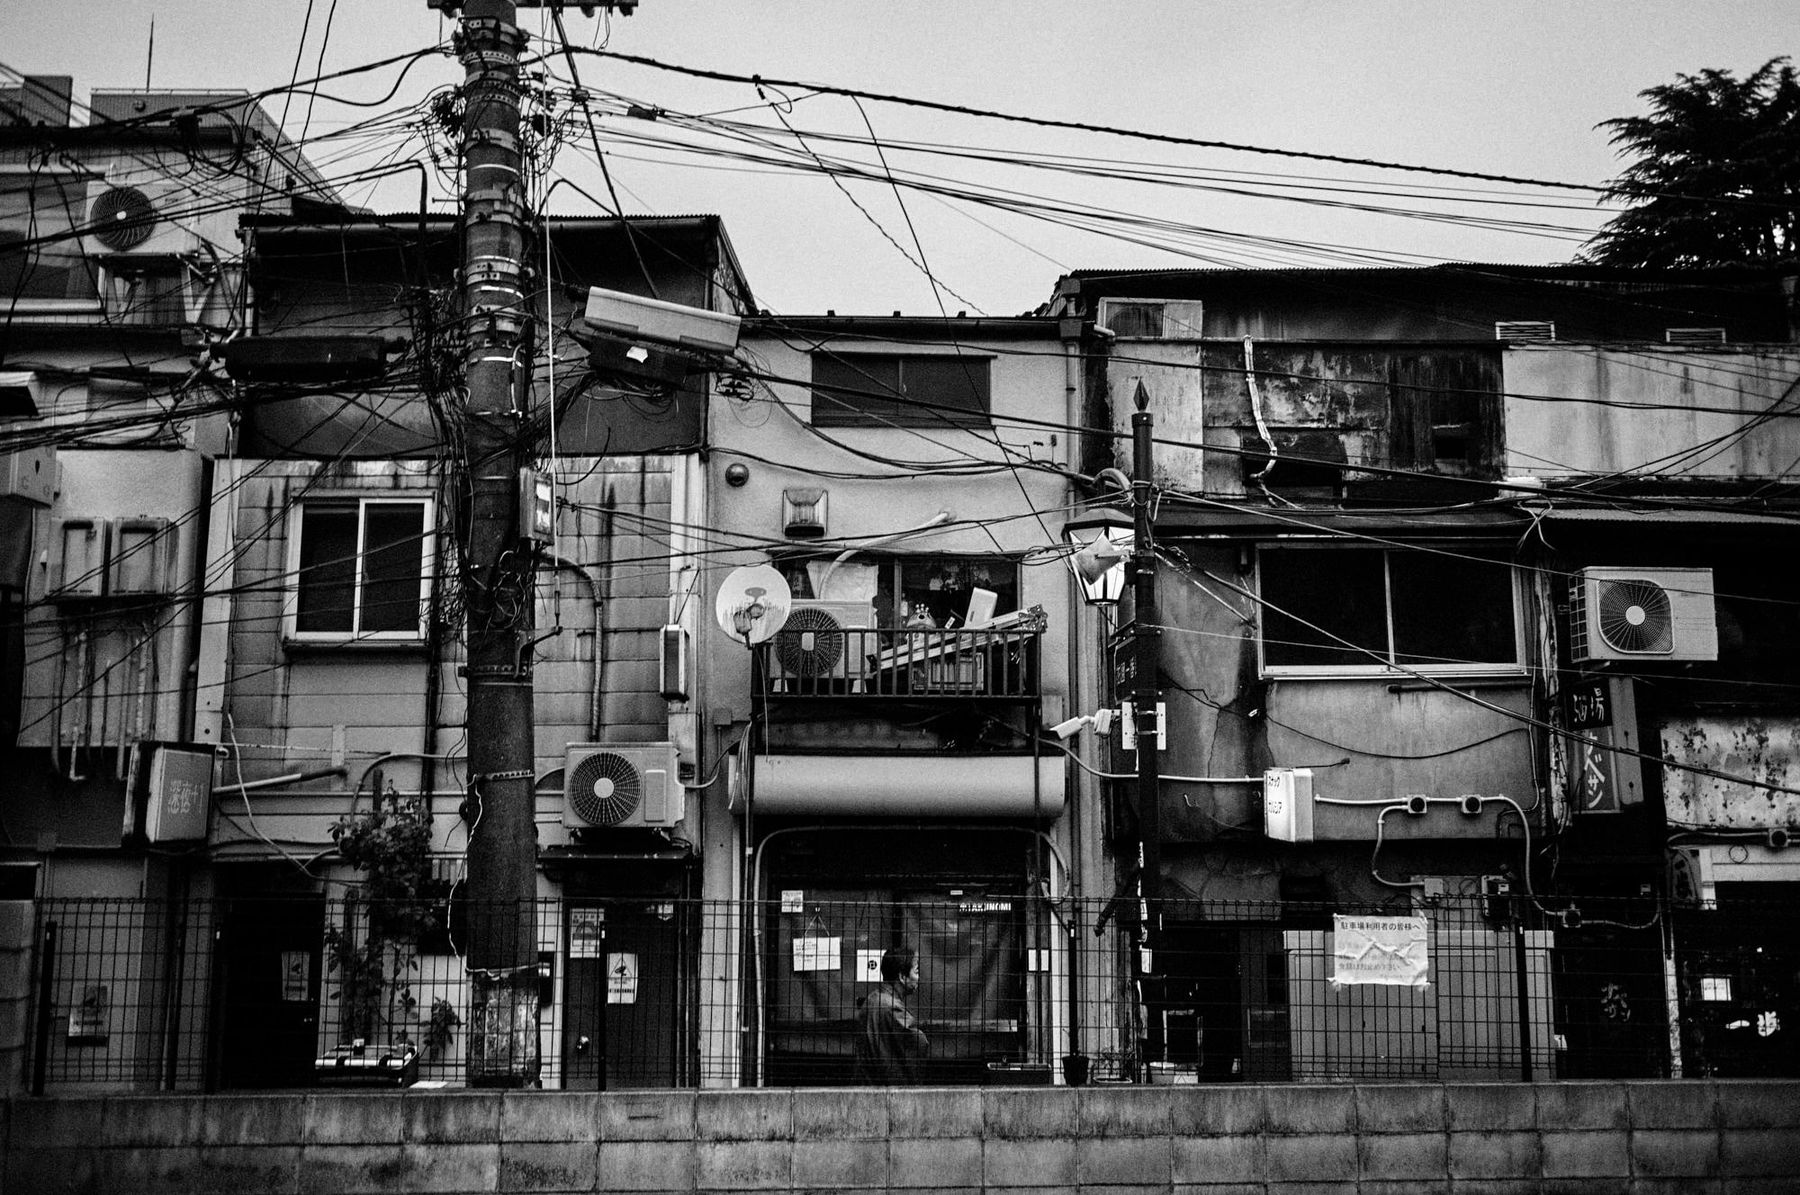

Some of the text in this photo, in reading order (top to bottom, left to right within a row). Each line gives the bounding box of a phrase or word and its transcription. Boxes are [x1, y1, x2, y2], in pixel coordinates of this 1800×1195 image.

[1340, 921, 1421, 931] 駐車場利用者の皆様へ
